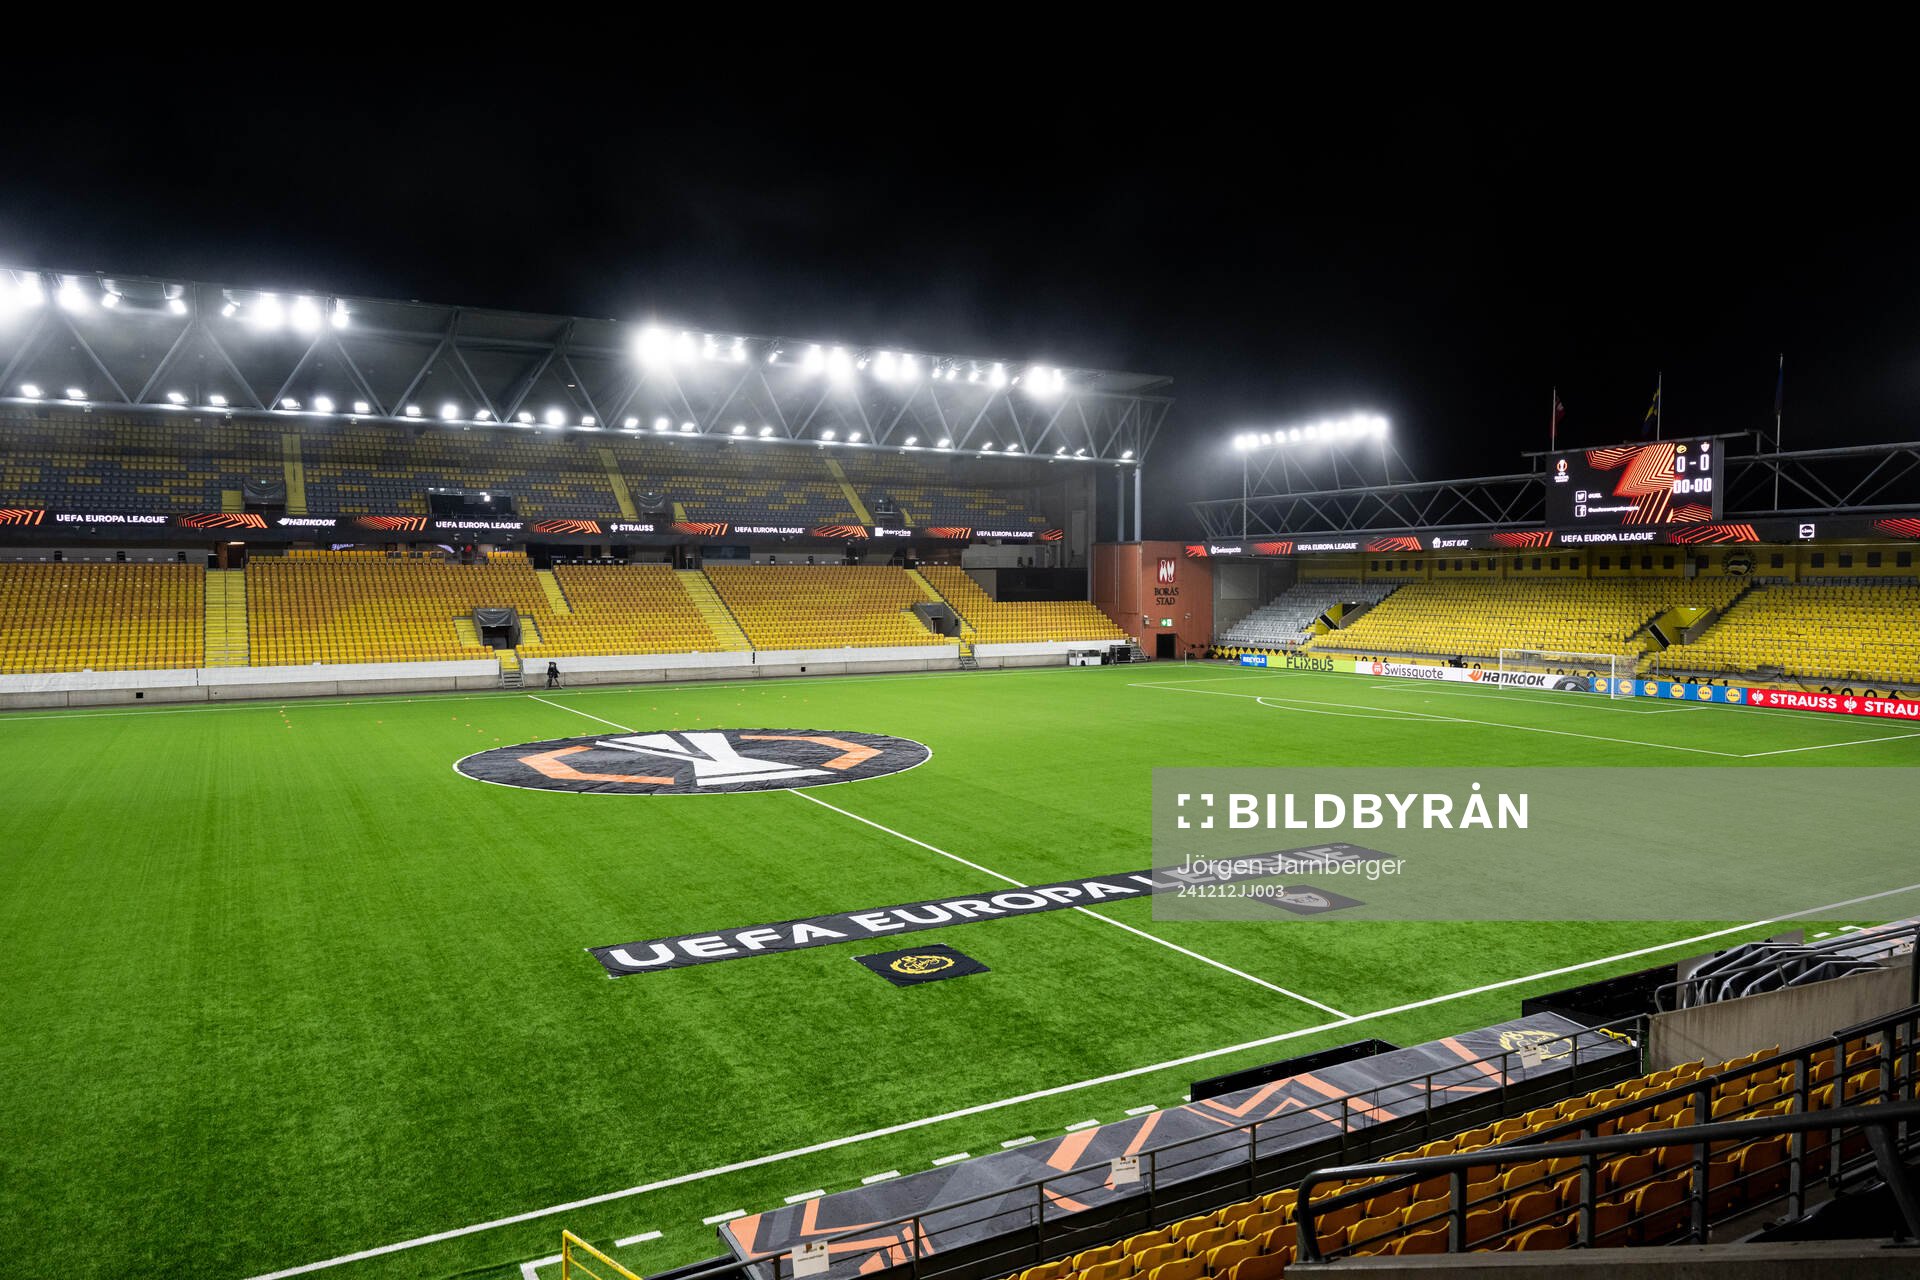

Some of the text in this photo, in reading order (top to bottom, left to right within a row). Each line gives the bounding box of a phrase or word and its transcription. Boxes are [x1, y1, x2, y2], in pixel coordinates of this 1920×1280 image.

[1676, 456, 1686, 473] 0
[1700, 454, 1710, 471] 0
[56, 514, 166, 523] UEFA EUROPA LEAGUE
[458, 521, 490, 529] EUROPA
[1561, 532, 1654, 543] UEFA EUROPA LEAGUE
[1441, 539, 1469, 548] JUST EAT
[1155, 596, 1176, 605] STAD
[1384, 663, 1444, 679] Swissquote
[1770, 693, 1837, 709] STRAUSS
[1864, 701, 1920, 716] STRAU
[608, 922, 849, 968] UEFA
[849, 881, 1139, 934] EUROPA
